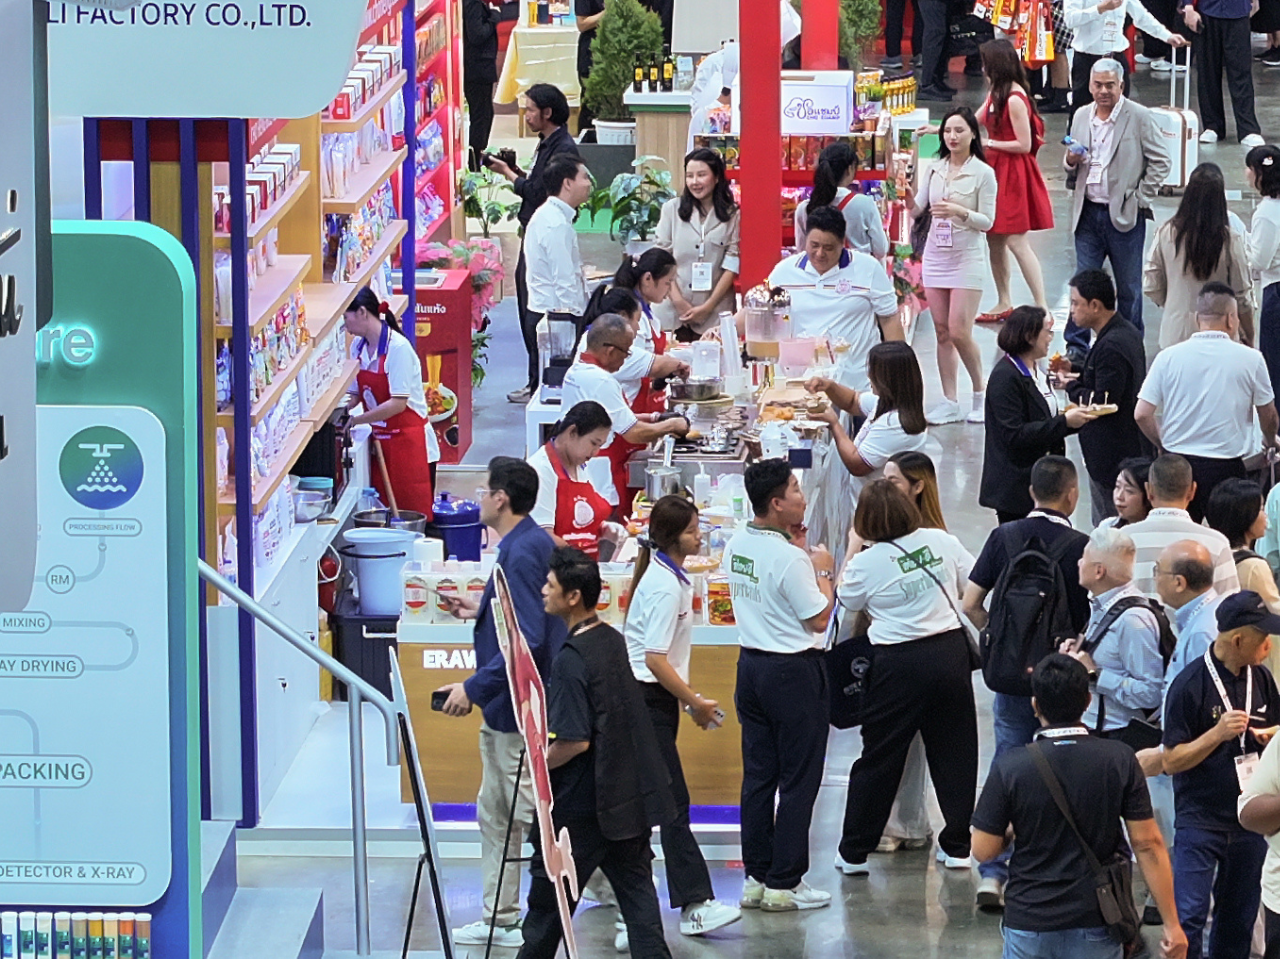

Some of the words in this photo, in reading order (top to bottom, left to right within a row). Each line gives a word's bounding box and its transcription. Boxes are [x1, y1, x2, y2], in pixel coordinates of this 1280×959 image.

[205, 3, 312, 29] CO.,LTD.
[115, 524, 136, 532] FLOW
[50, 574, 70, 586] RM
[2, 617, 46, 628] MIXING
[21, 660, 77, 673] DRYING
[77, 866, 87, 879] &
[91, 866, 135, 879] X-RAY
